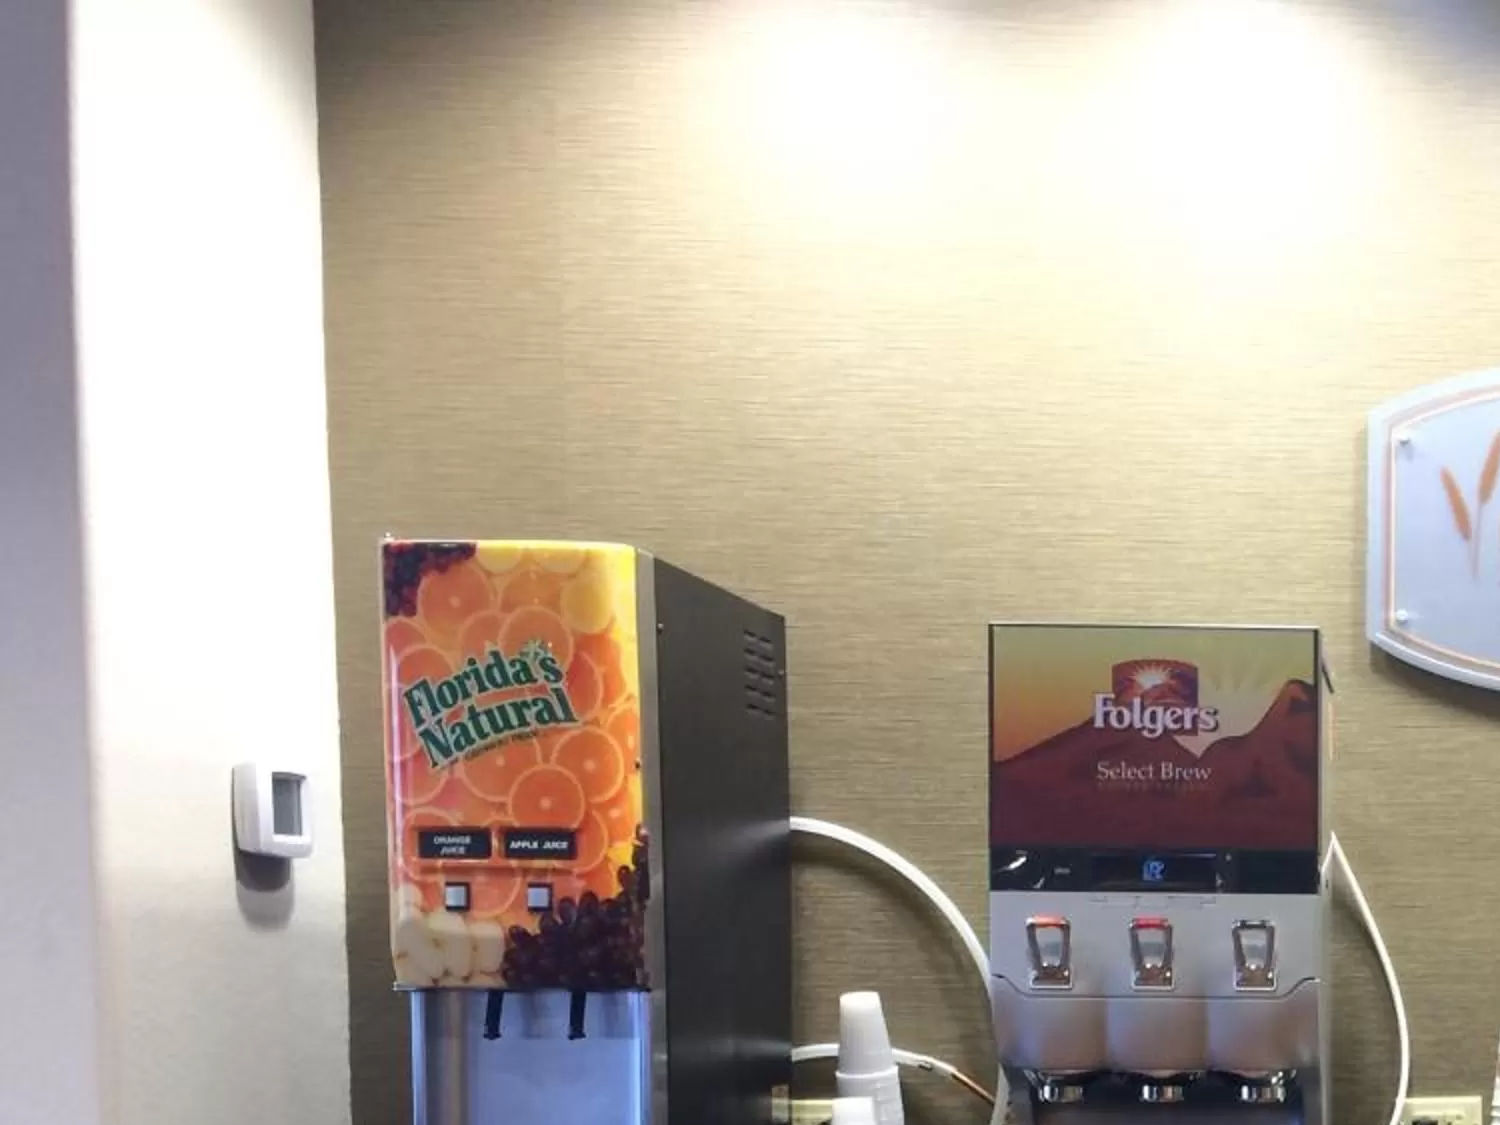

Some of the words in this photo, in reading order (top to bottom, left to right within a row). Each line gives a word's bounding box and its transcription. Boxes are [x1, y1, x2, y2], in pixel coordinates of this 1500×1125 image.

[403, 645, 564, 728] Florida's
[418, 687, 579, 768] Natural
[1094, 692, 1220, 738] Folgers
[1097, 760, 1153, 780] Select
[1160, 760, 1212, 780] Brew
[509, 840, 539, 849] APPLE
